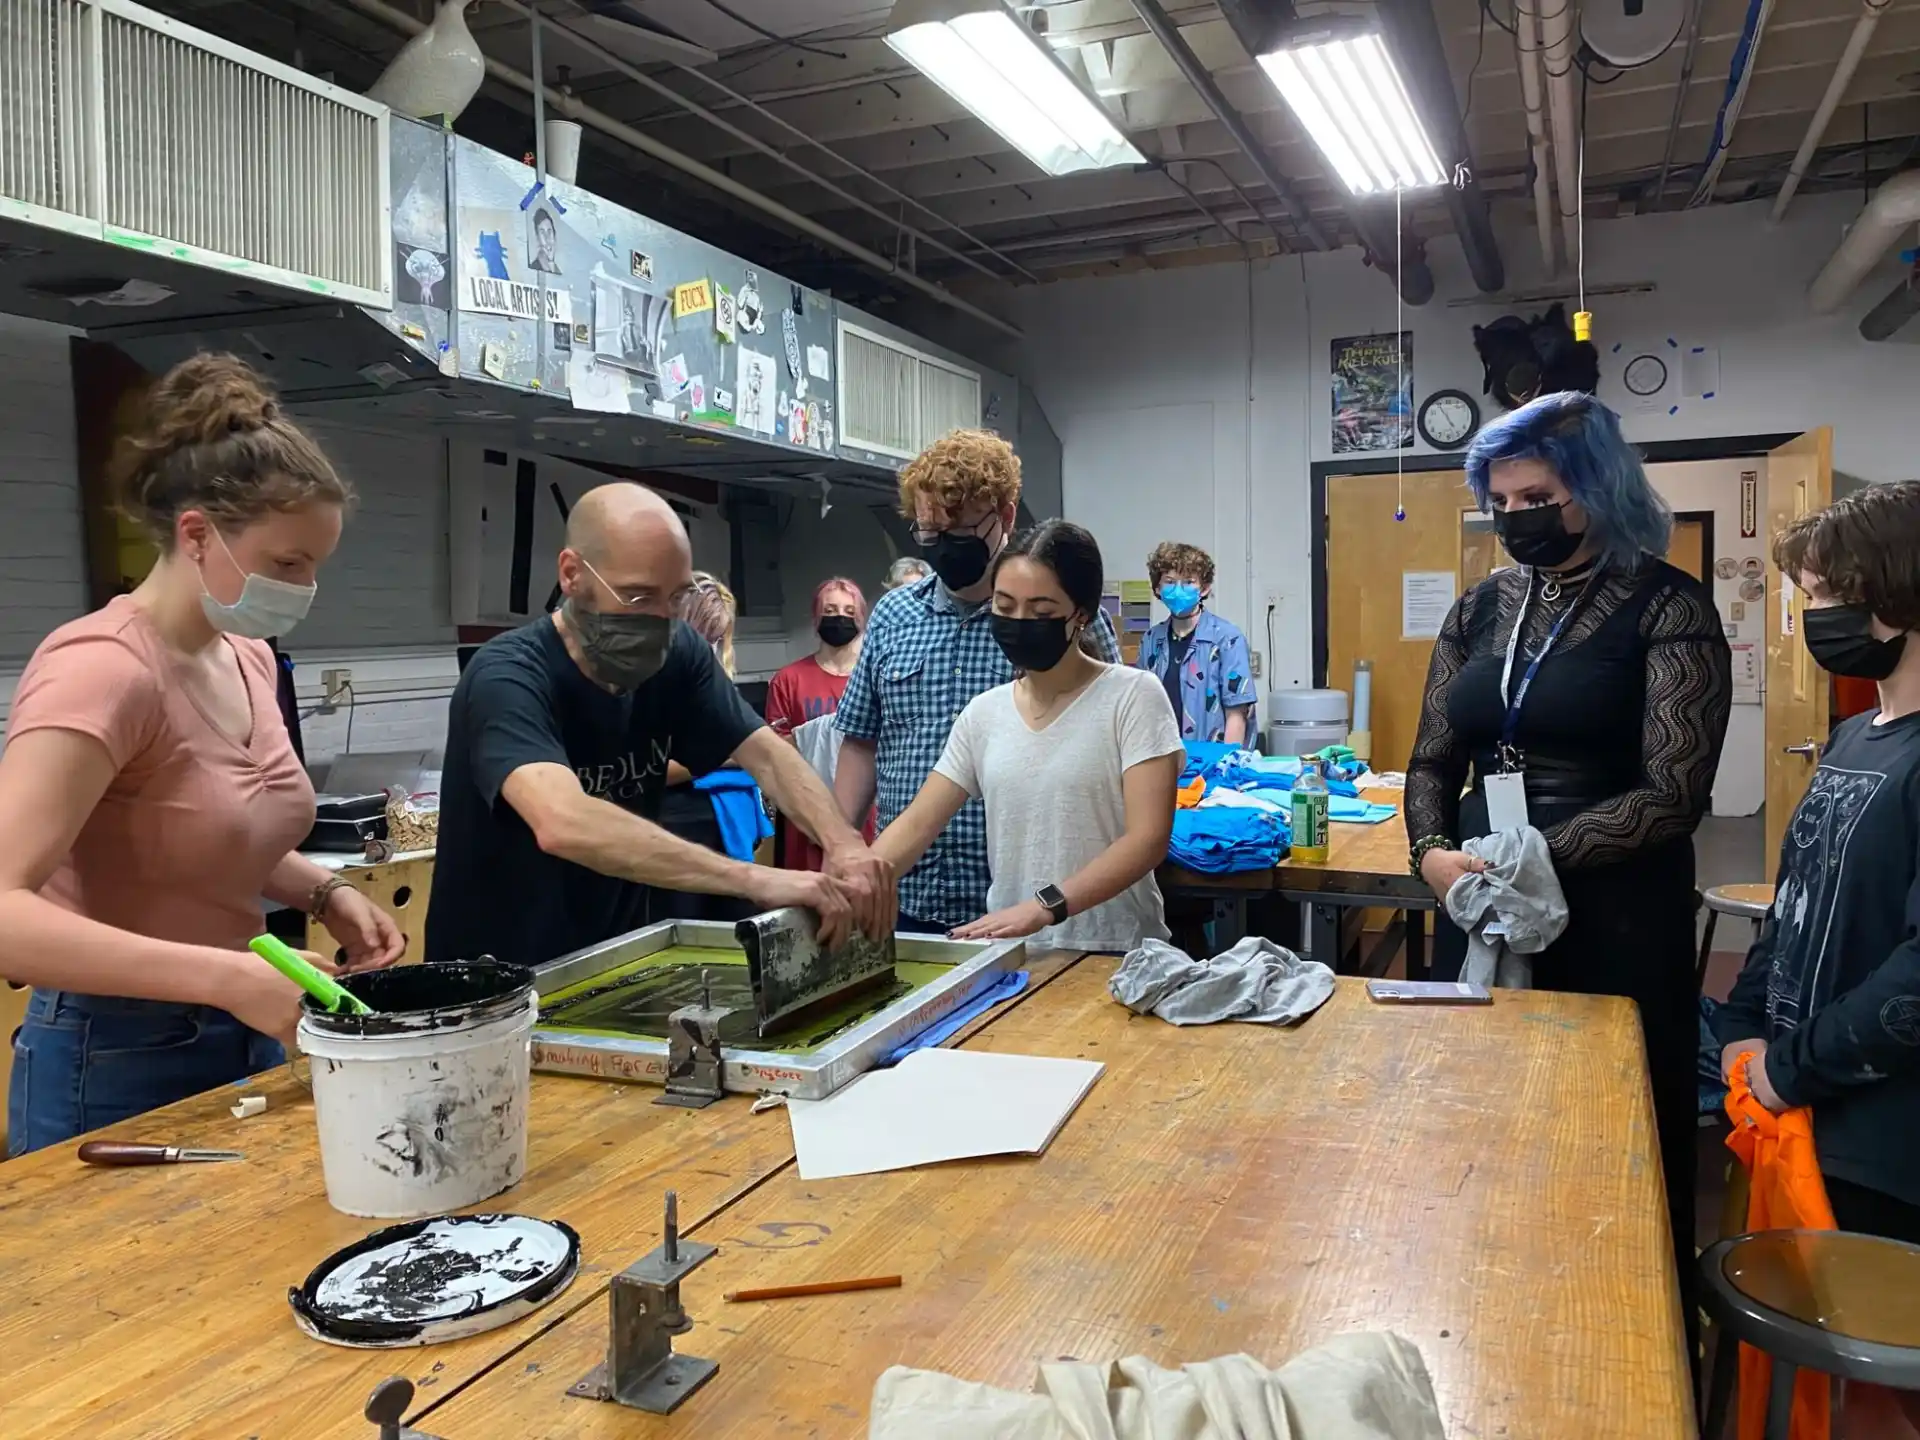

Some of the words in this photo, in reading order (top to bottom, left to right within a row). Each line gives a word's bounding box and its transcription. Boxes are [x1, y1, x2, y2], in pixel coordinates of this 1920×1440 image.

[470, 276, 509, 311] LOCAL
[510, 283, 560, 319] ARTISS!
[680, 285, 707, 312] FUCK
